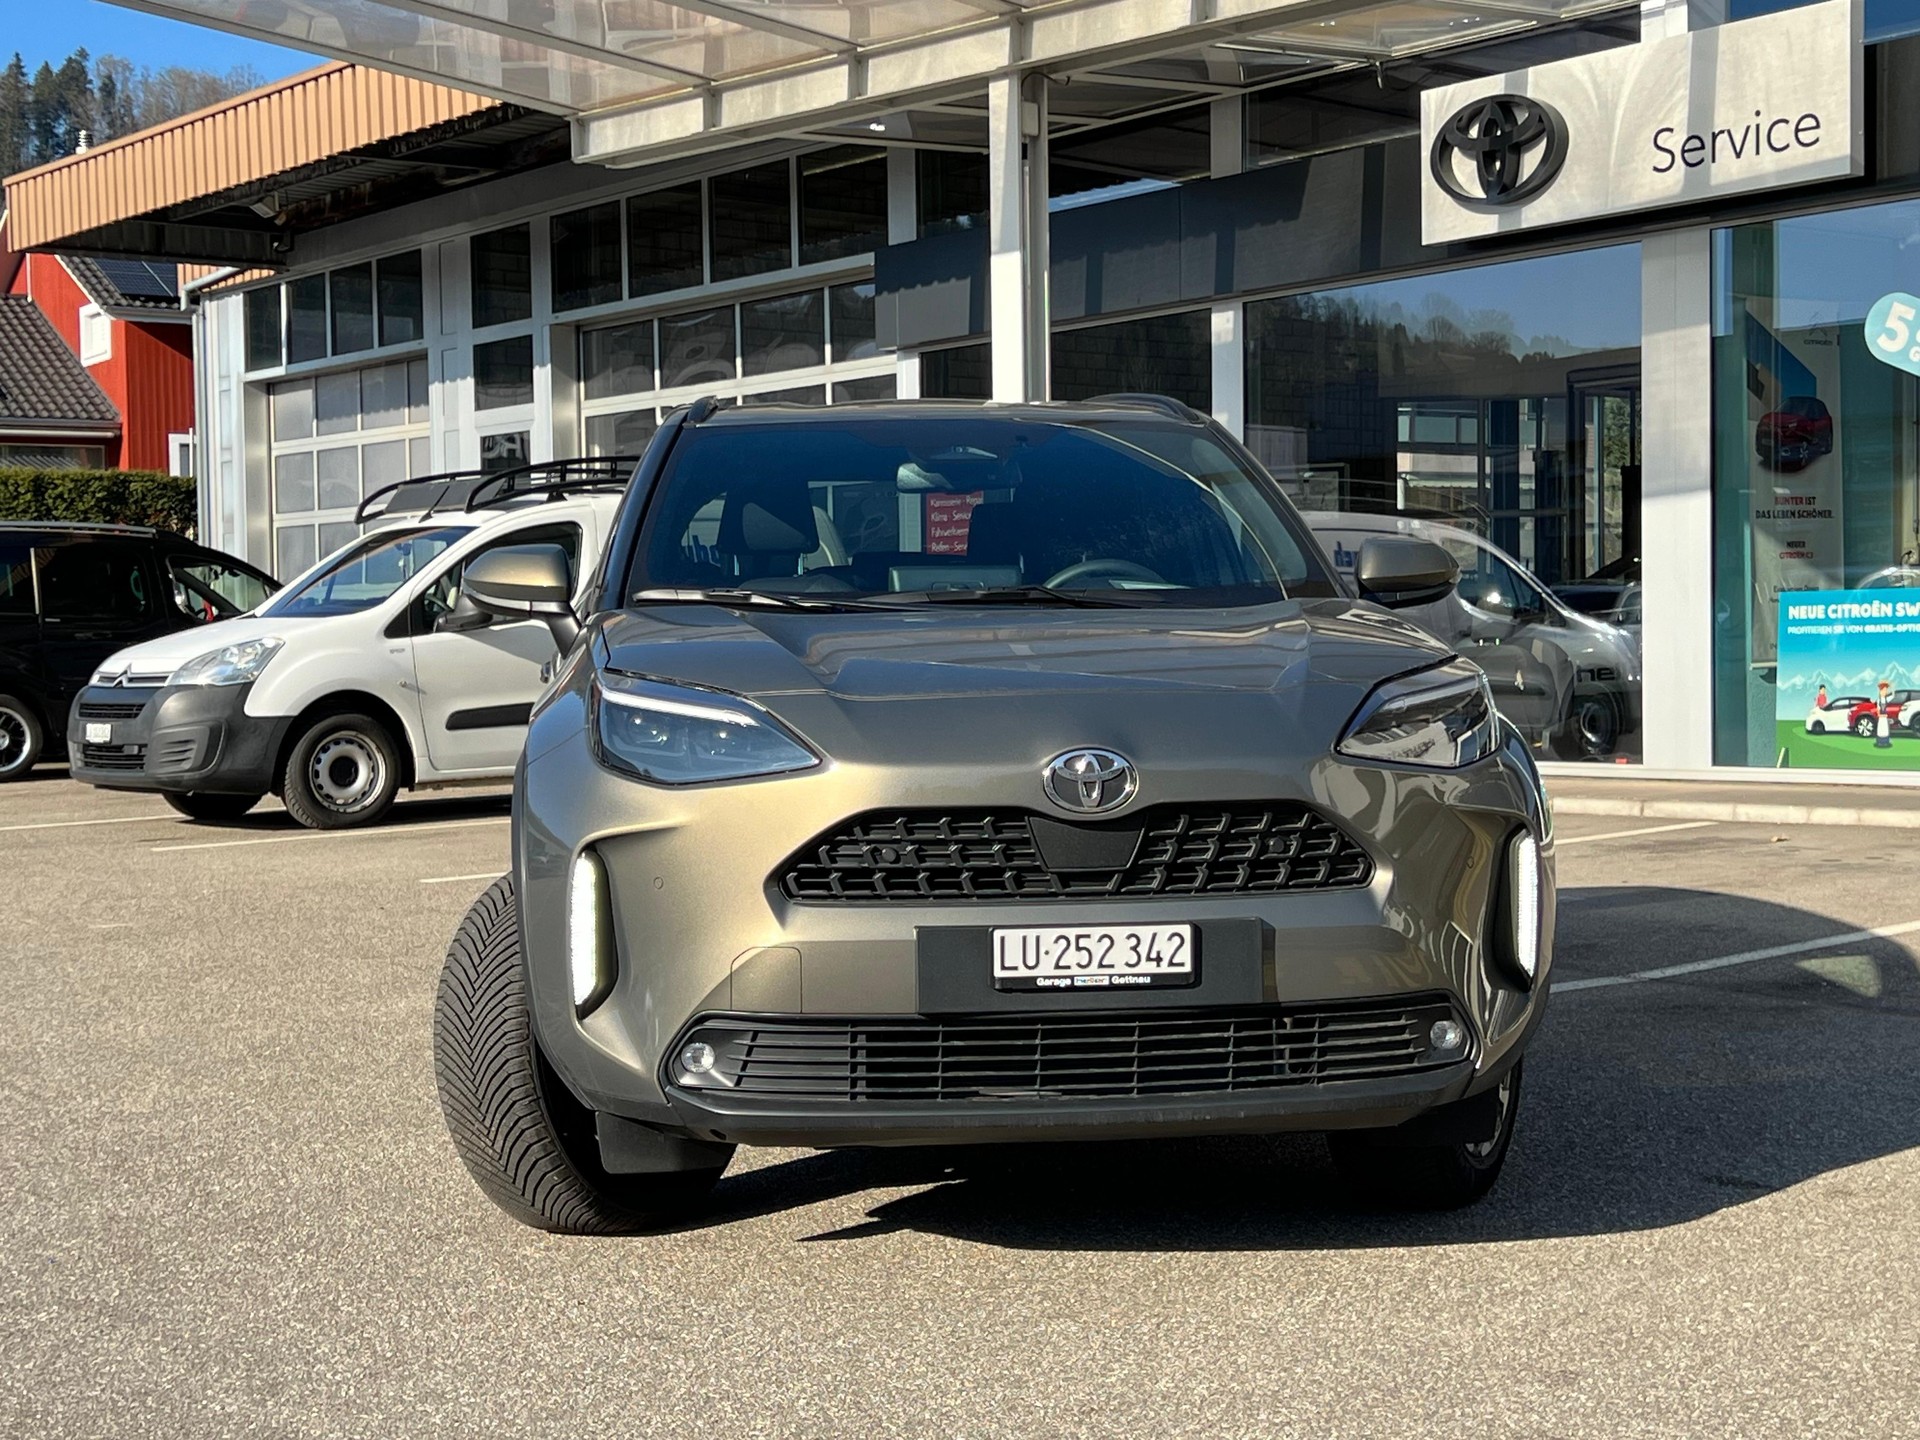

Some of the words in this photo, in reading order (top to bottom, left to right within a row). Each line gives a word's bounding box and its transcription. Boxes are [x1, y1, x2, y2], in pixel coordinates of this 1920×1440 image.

[1652, 109, 1821, 174] Service
[1877, 301, 1916, 353] 5
[1805, 496, 1817, 506] IST
[1755, 509, 1771, 520] DAS
[1773, 509, 1796, 519] LEBEN
[1788, 605, 1826, 620] NEUE
[1827, 600, 1893, 619] CITROËN
[1846, 624, 1864, 634] VON
[1036, 977, 1072, 988] Garage
[1111, 975, 1152, 985] Gettnau
